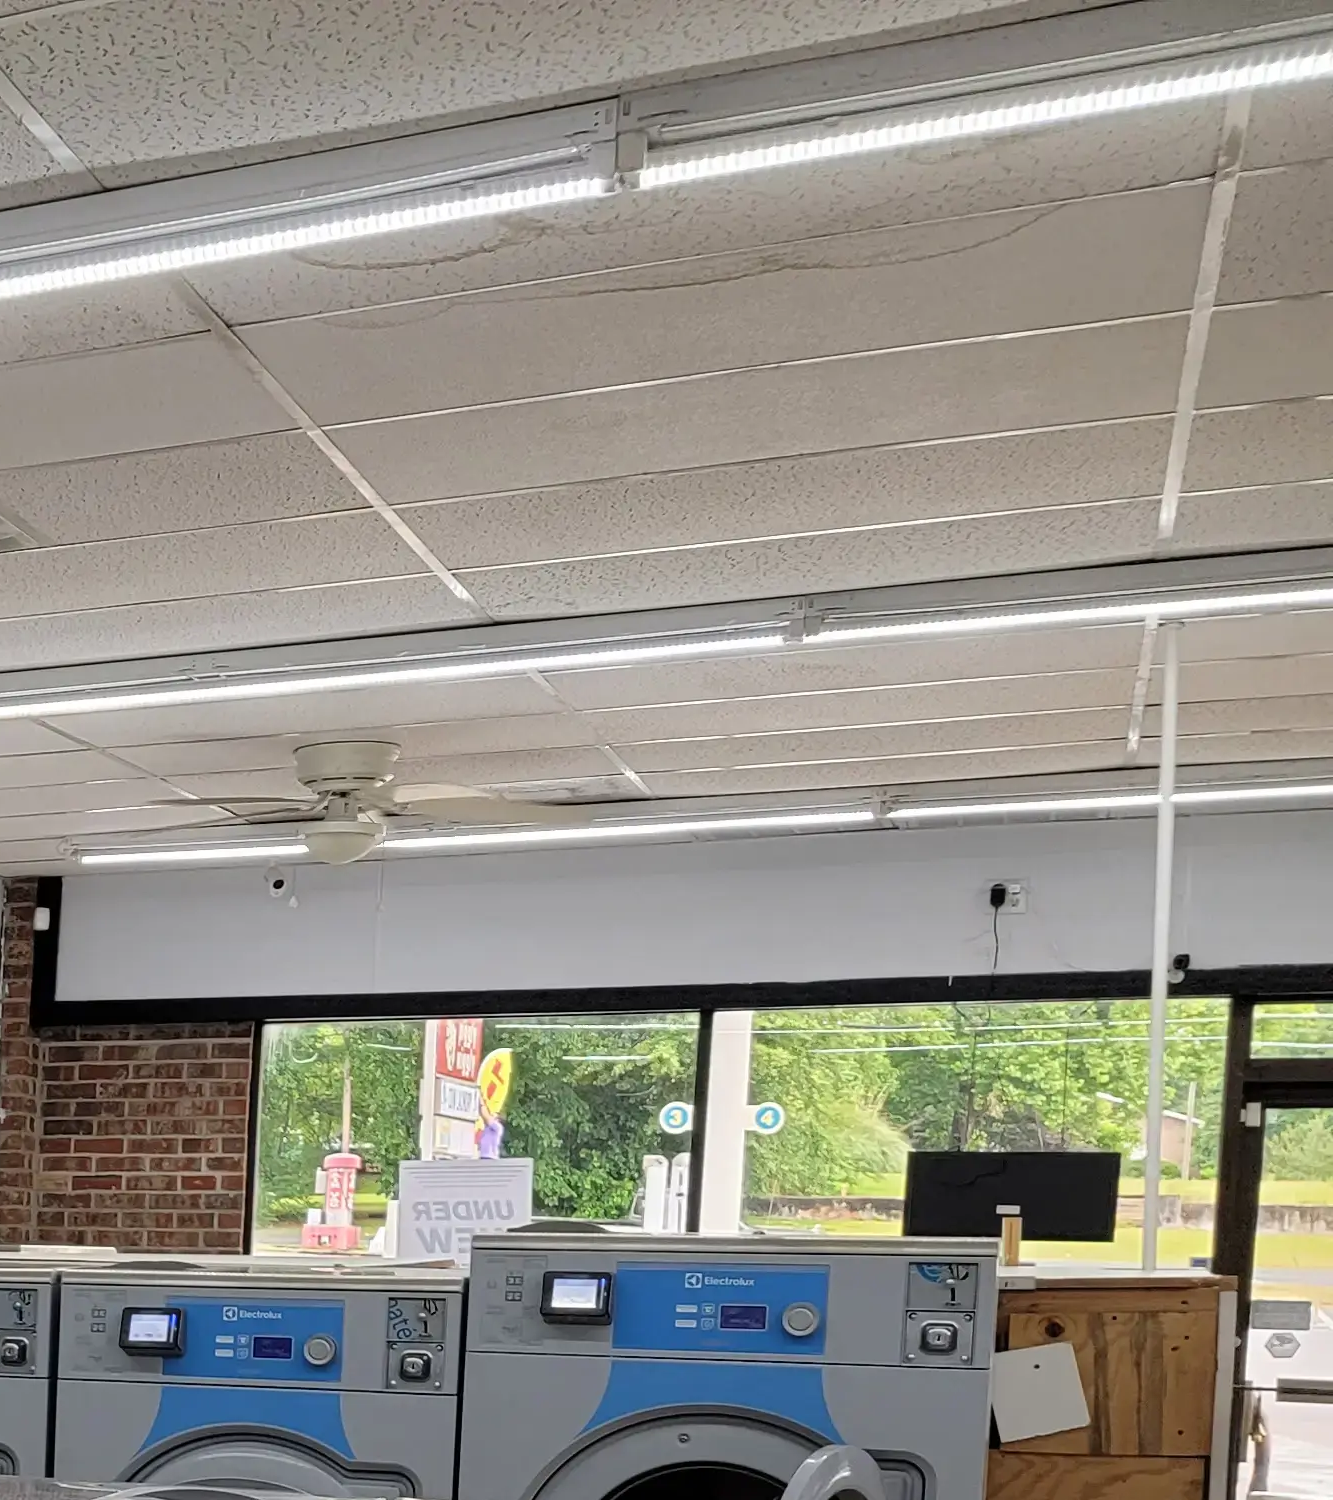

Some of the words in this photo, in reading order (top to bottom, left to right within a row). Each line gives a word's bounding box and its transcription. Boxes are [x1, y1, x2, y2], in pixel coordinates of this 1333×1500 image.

[669, 1109, 682, 1126] 3
[760, 1109, 774, 1126] 4
[704, 1276, 754, 1288] Electrolux
[239, 1309, 282, 1320] Electrolux
